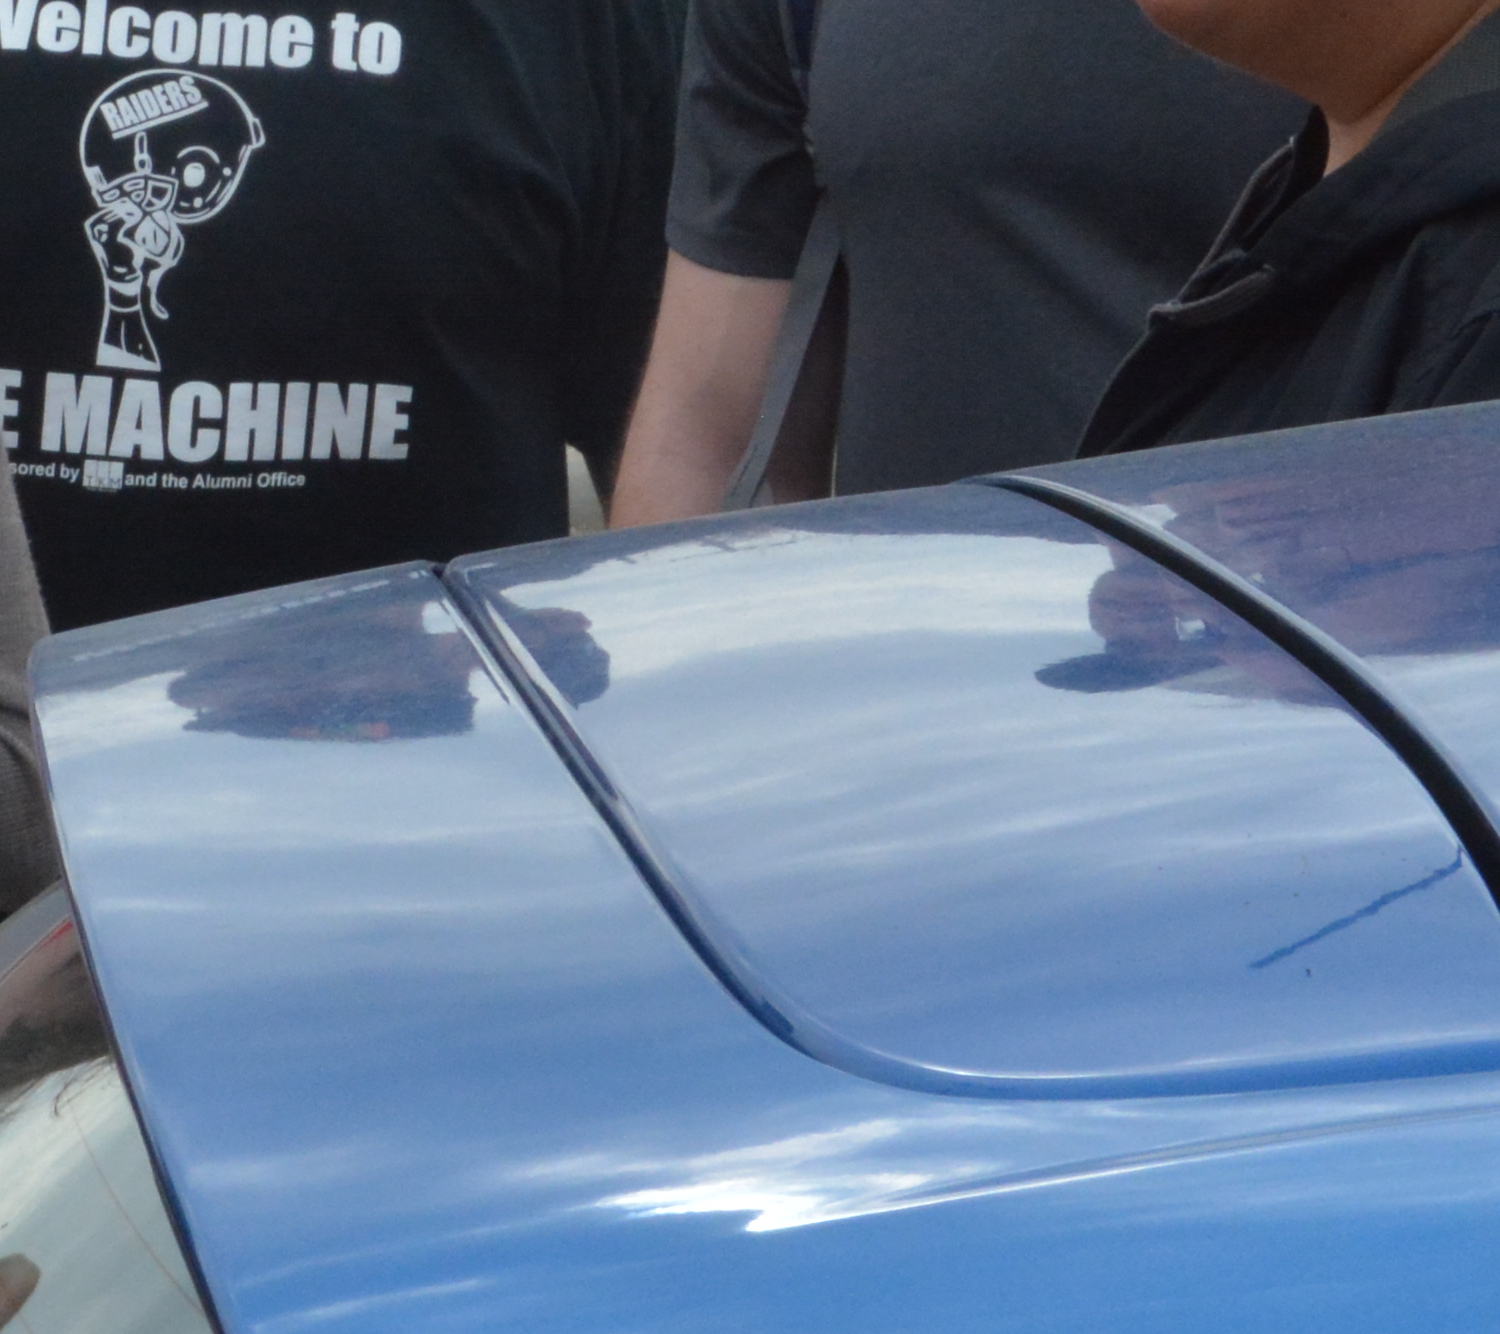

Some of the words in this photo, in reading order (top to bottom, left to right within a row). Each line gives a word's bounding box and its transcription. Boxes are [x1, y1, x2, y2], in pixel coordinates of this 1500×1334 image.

[330, 12, 402, 76] to
[100, 75, 204, 133] RAIDERS
[40, 371, 414, 463] MACHINE
[59, 463, 80, 483] by
[124, 472, 157, 487] and
[161, 474, 188, 488] the
[192, 473, 252, 489] Alumni
[256, 471, 306, 488] Office
